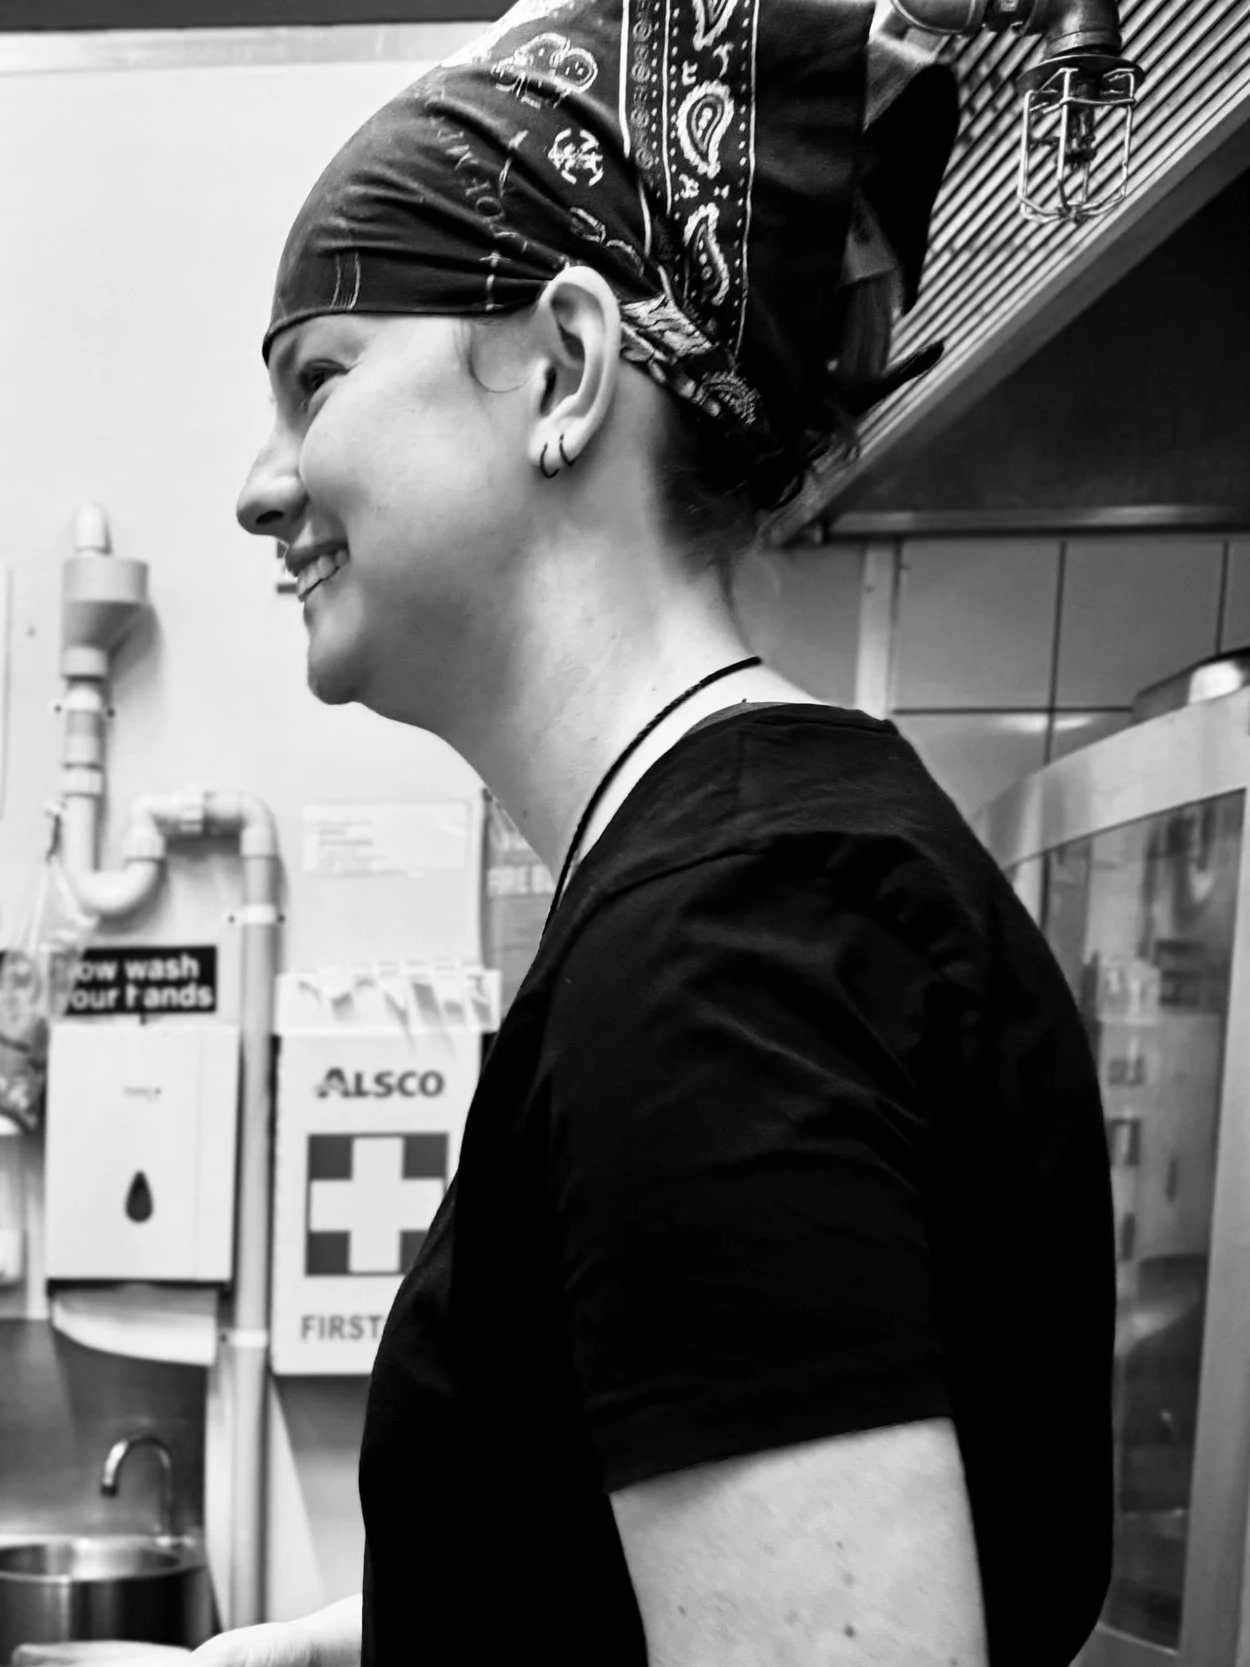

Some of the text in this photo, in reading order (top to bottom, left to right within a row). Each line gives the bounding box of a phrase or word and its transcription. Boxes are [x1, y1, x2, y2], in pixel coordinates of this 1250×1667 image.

[66, 953, 199, 982] ow wash
[62, 982, 213, 1010] our hands
[317, 1067, 445, 1098] ALSCO
[301, 1314, 383, 1340] FIRST
